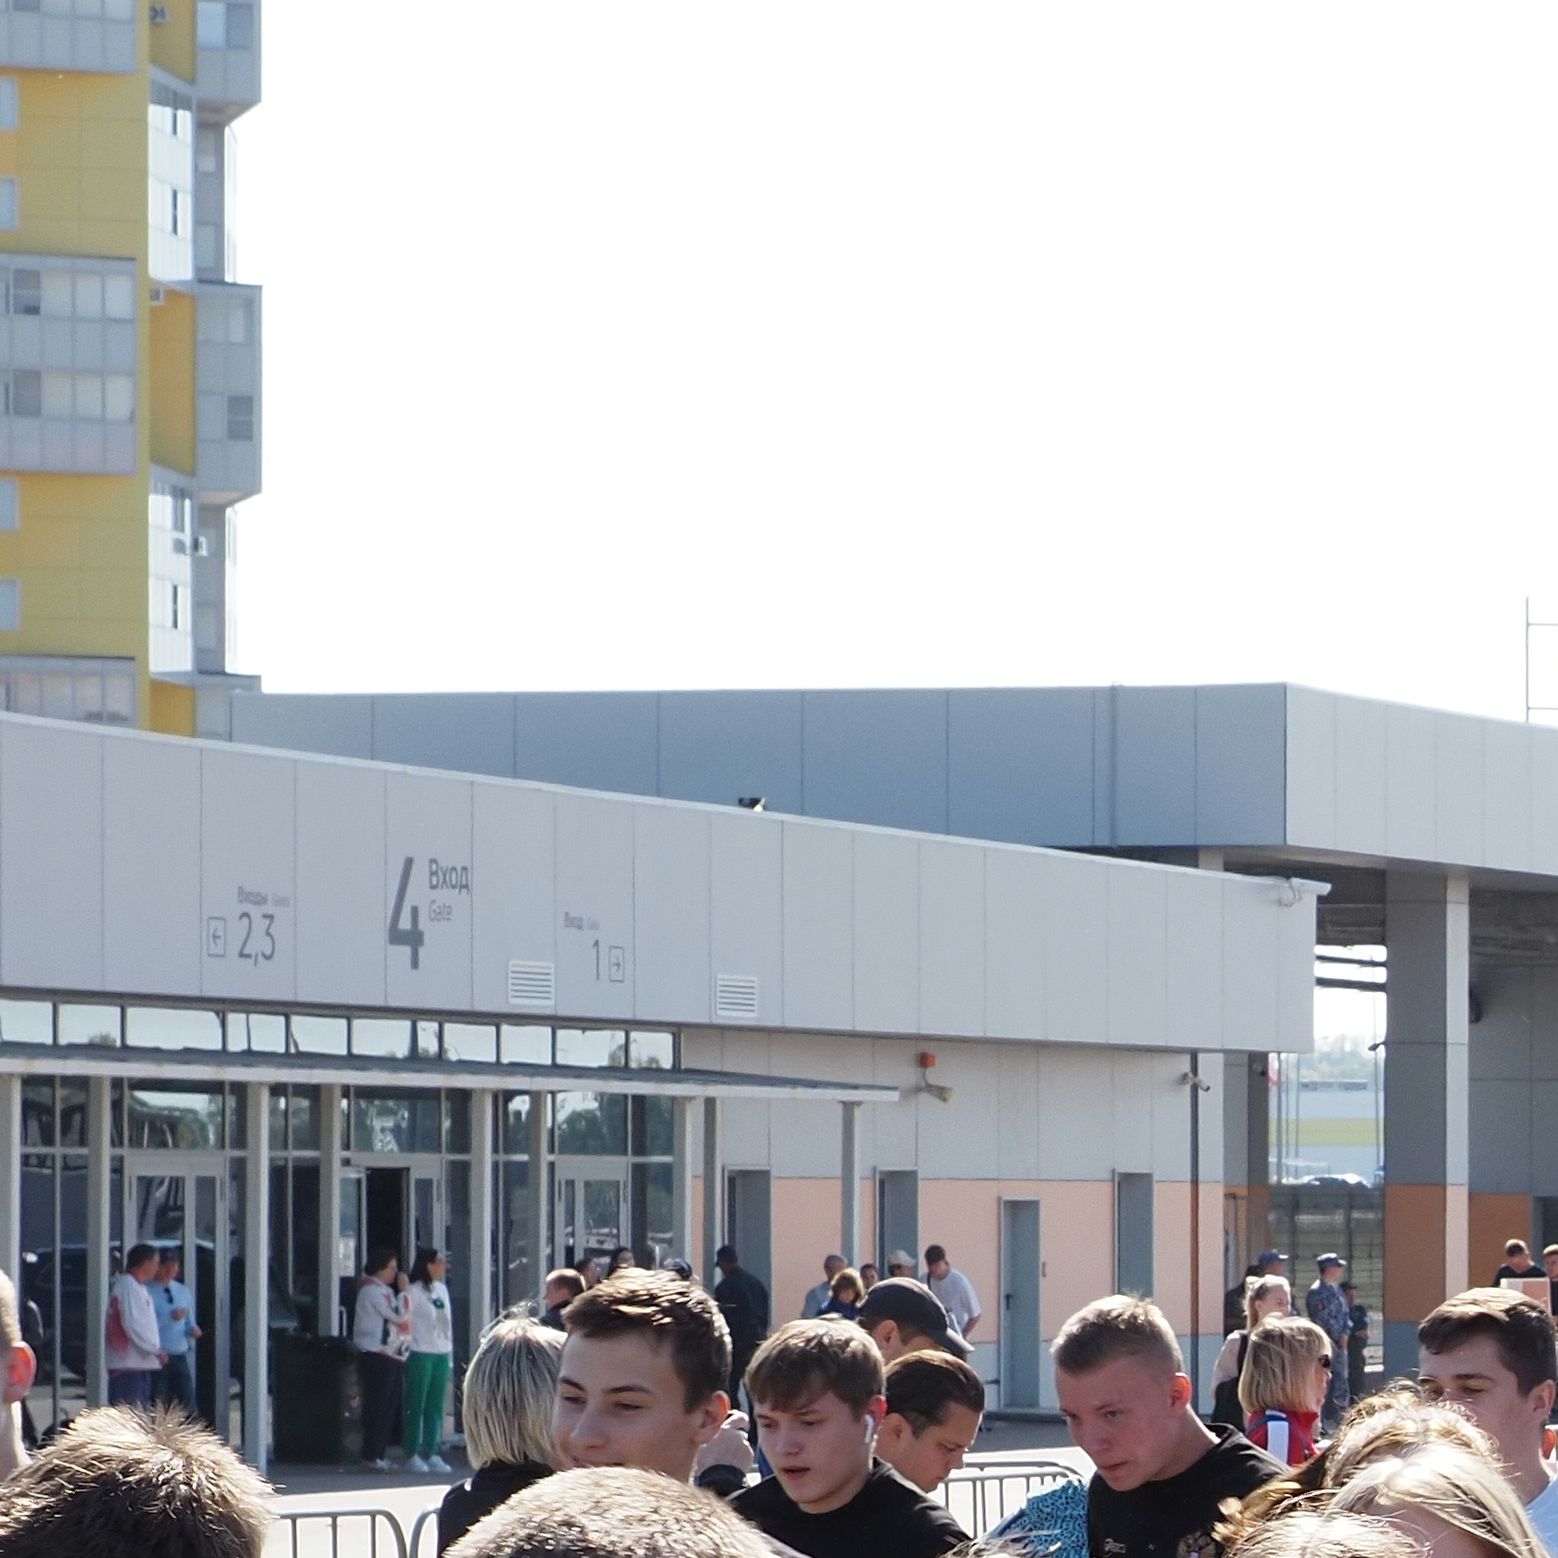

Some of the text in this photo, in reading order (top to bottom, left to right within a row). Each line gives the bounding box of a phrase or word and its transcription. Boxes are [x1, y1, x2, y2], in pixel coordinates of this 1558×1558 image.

[428, 859, 470, 894] Вход
[388, 856, 424, 970] 4
[428, 900, 453, 922] Gate
[237, 912, 276, 967] 2,3
[592, 939, 601, 981] 1
